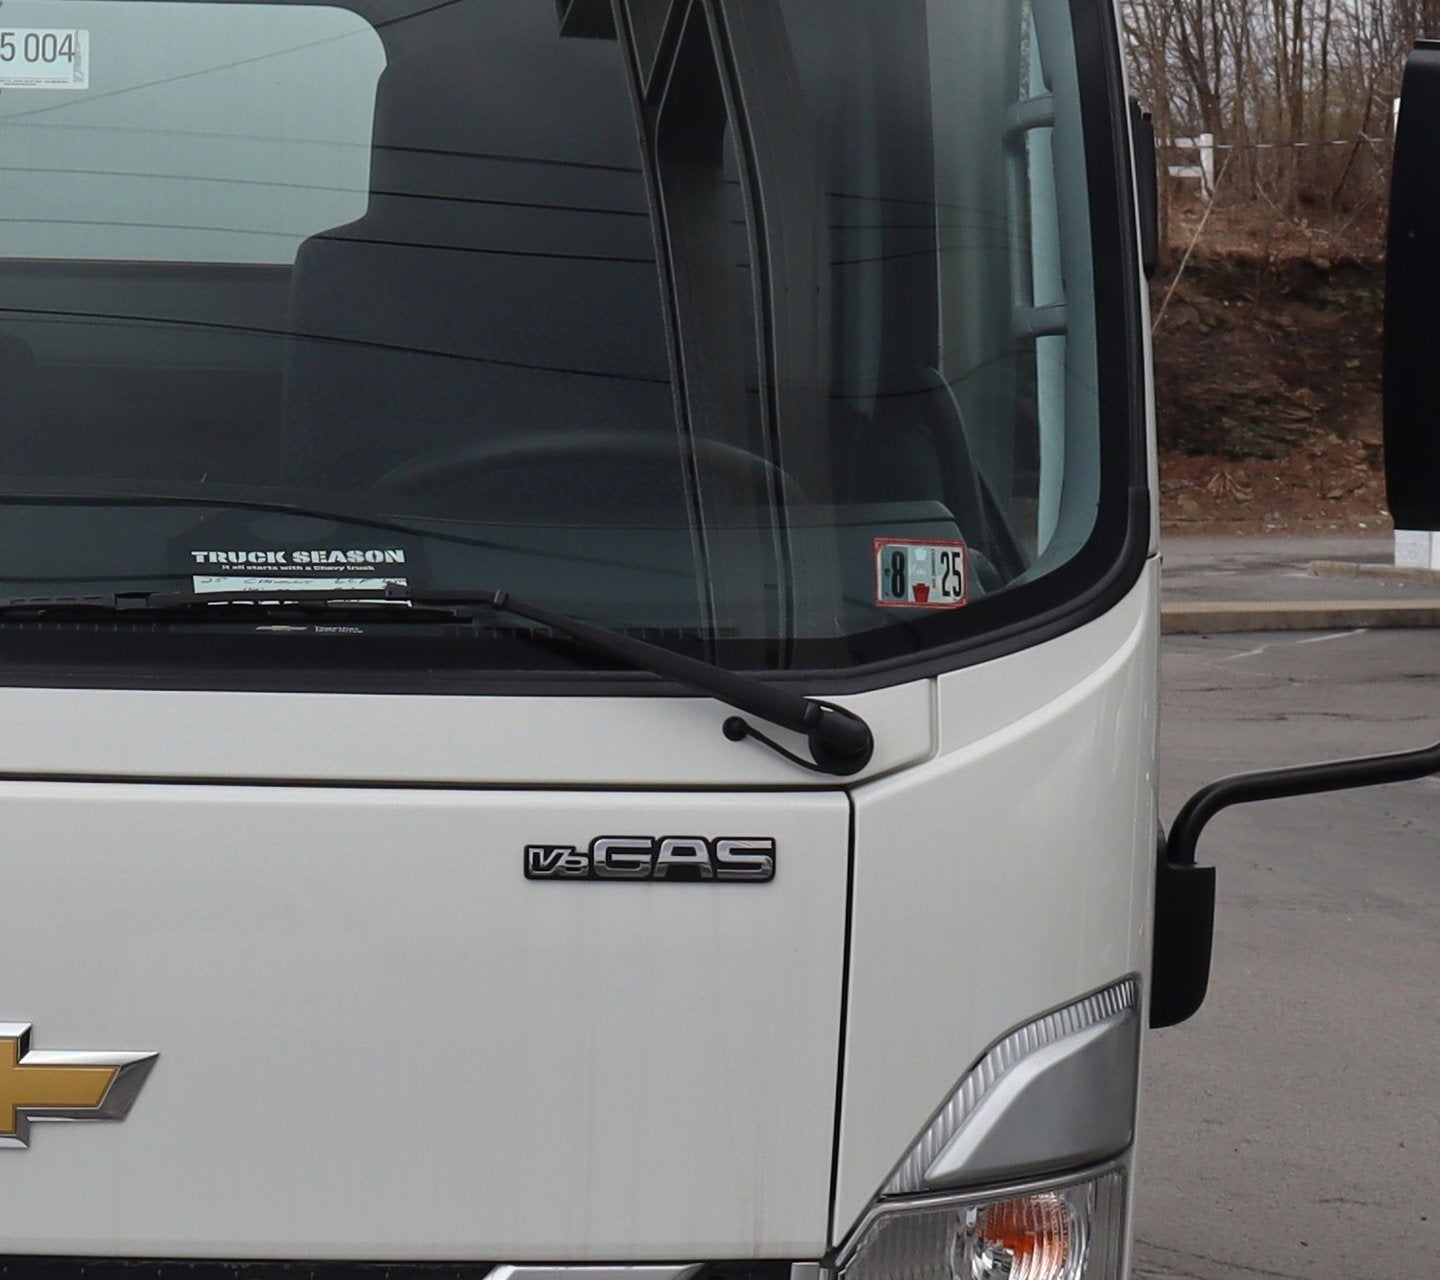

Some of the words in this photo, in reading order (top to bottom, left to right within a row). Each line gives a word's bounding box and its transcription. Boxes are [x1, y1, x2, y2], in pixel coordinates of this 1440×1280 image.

[23, 32, 77, 64] 004
[191, 550, 288, 564] TRUCK
[291, 549, 406, 564] SEASON
[891, 550, 906, 599] 8
[940, 550, 962, 598] 25
